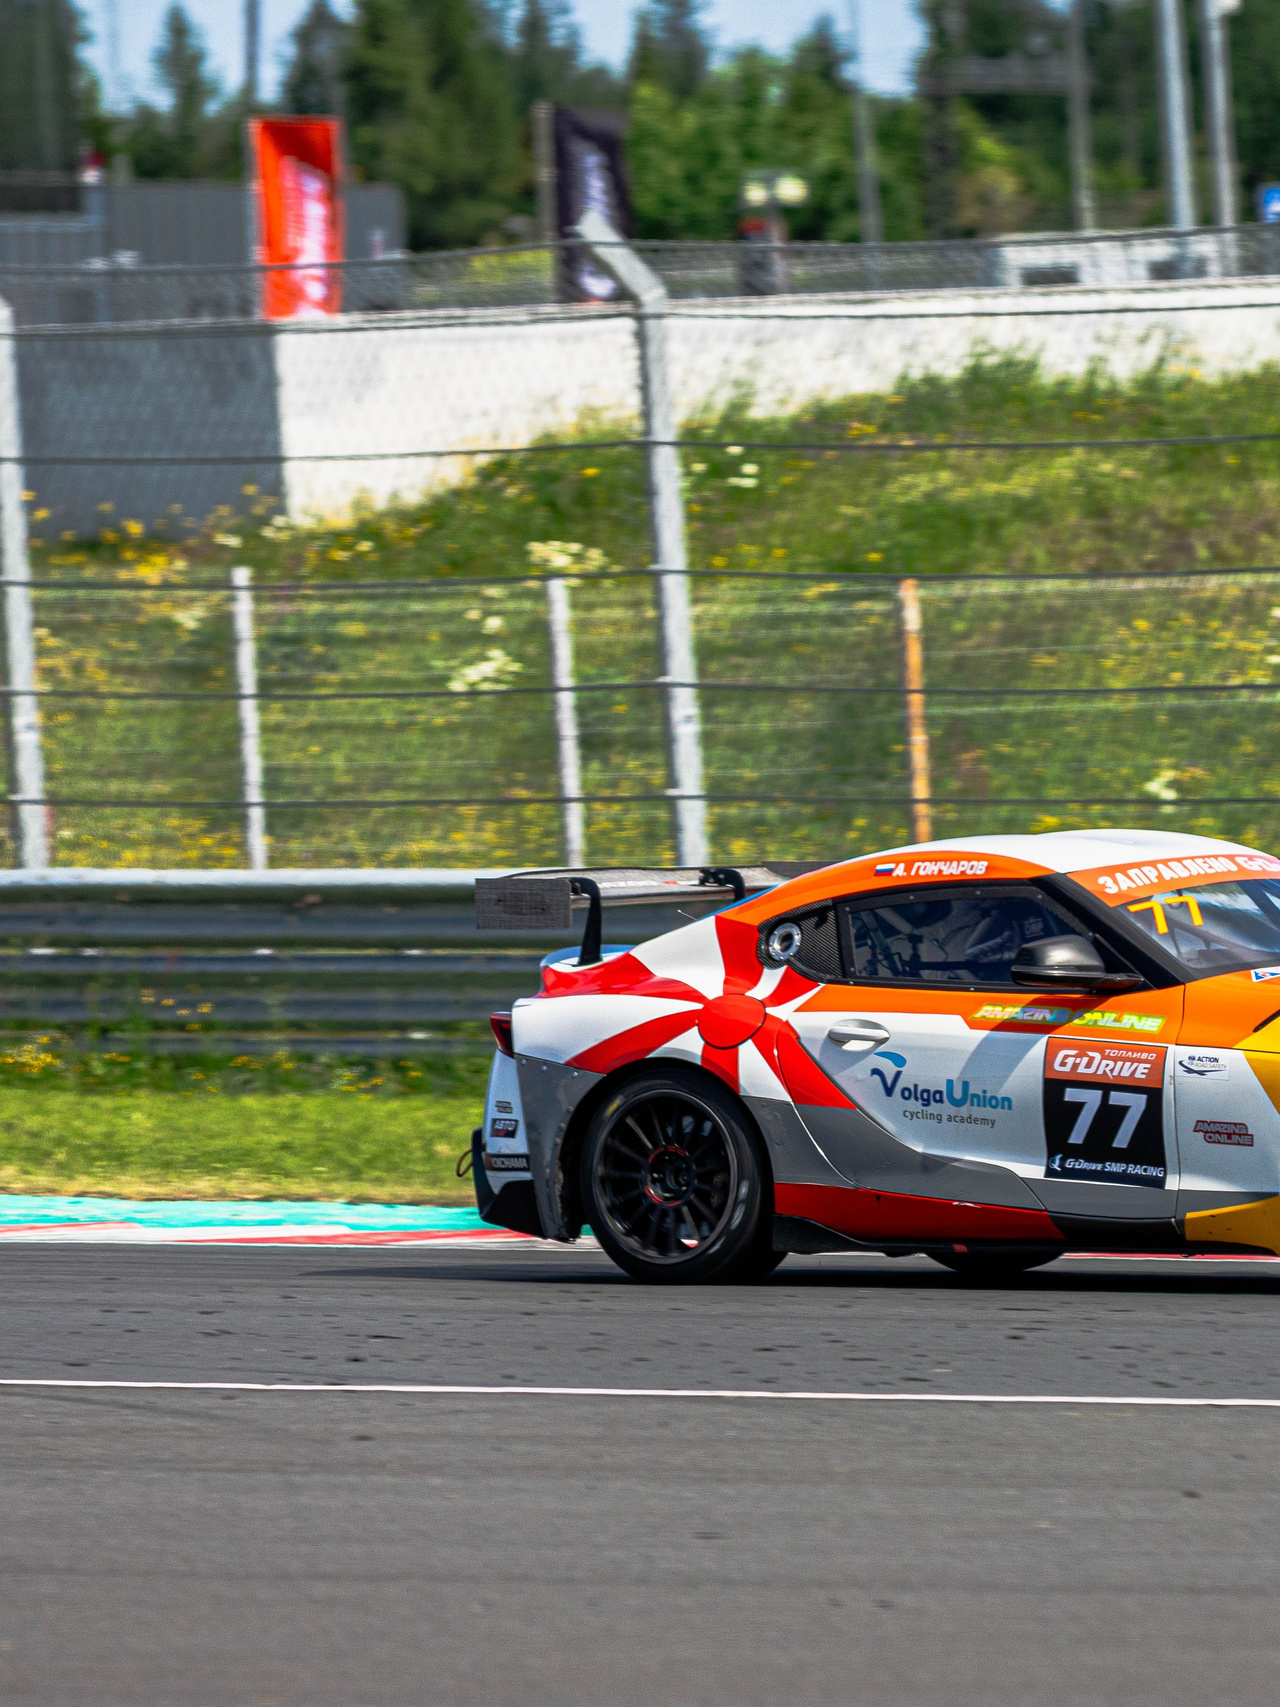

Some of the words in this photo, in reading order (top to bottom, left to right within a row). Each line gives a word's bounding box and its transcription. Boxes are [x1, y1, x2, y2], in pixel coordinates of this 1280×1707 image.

[892, 862, 907, 877] А.
[910, 861, 989, 877] ГОНЧАРОВ
[1097, 856, 1238, 894] ЗАПРАВЛЕНО
[1126, 894, 1204, 935] 77
[974, 1005, 1070, 1024] AMAZING
[1072, 1010, 1164, 1032] ONLINE
[1104, 1049, 1157, 1060] ТОПЛИВО
[903, 1108, 943, 1124] cycling
[946, 1112, 996, 1129] academy
[1063, 1087, 1148, 1149] 77
[1195, 1121, 1248, 1134] AMAZING
[1205, 1133, 1252, 1145] ONLINE
[1104, 1162, 1126, 1173] SMP
[1127, 1164, 1165, 1177] RACING
